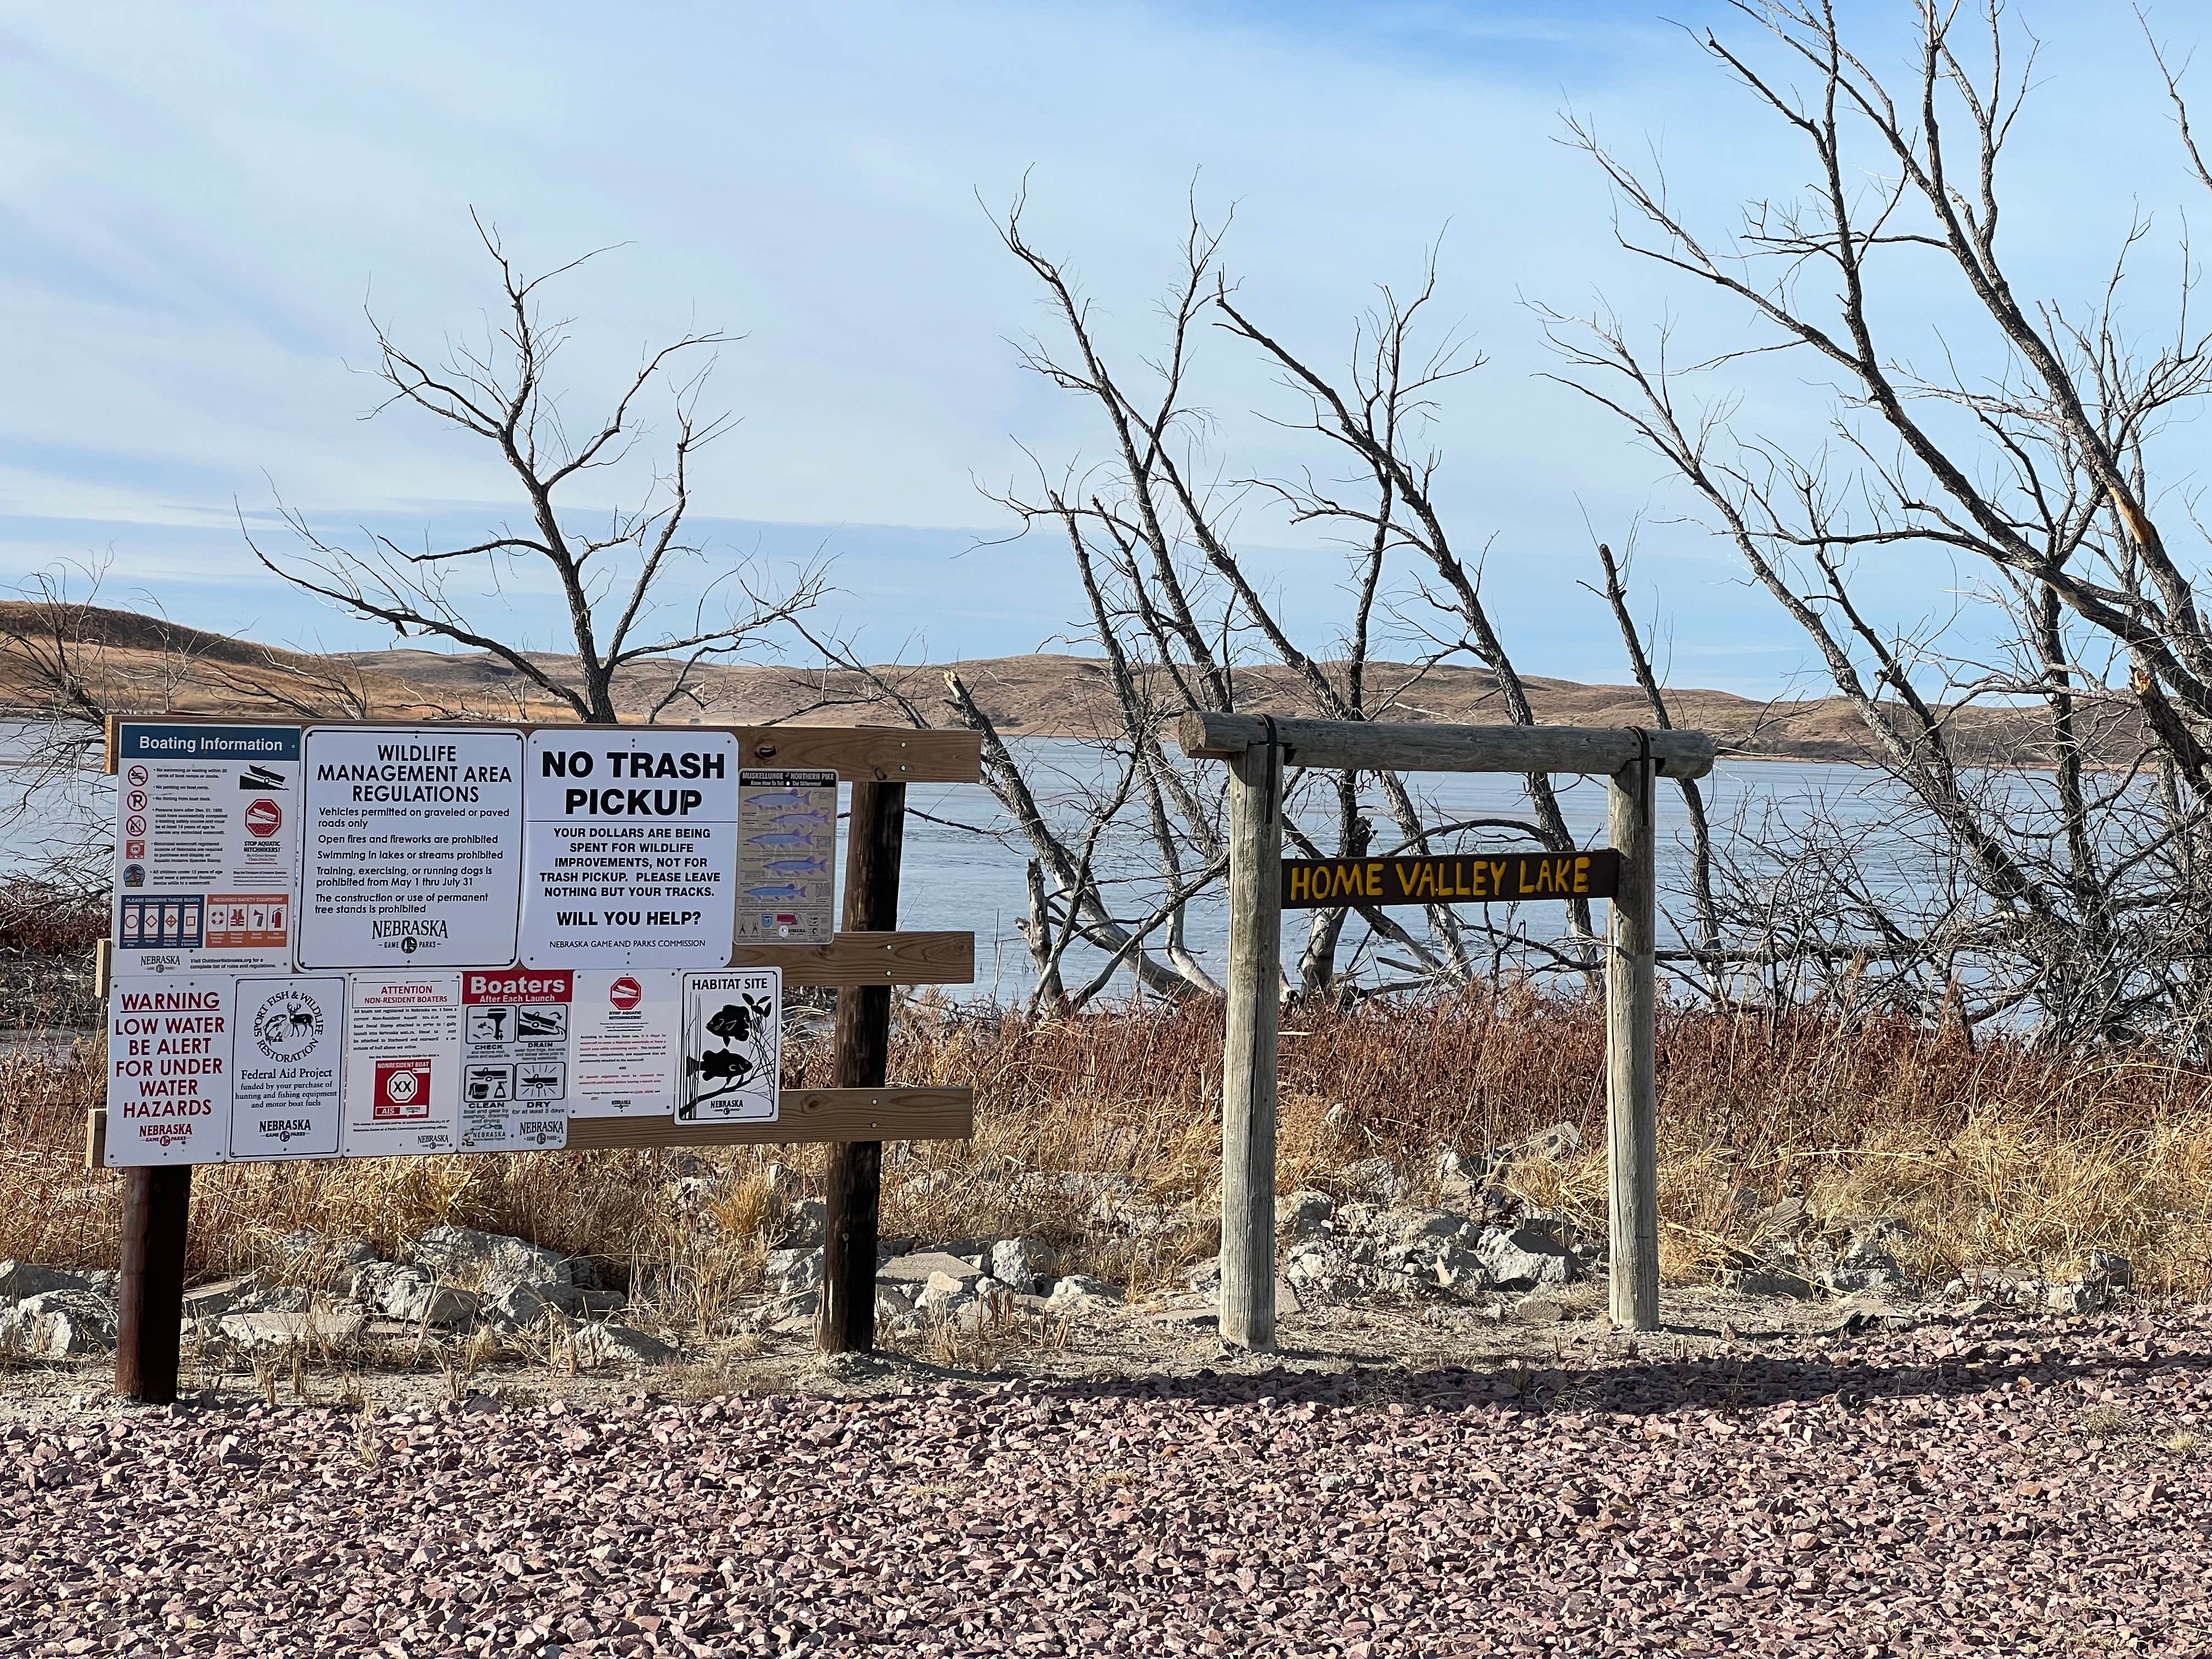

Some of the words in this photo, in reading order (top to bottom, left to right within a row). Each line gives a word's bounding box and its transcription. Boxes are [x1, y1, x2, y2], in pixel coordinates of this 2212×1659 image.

[140, 736, 195, 752] Boating
[201, 737, 282, 751] Information
[377, 745, 455, 761] WILDLIFE
[543, 752, 593, 777] NO
[607, 752, 724, 778] TRASH
[318, 765, 458, 782] MANAGEMENT
[464, 766, 511, 782] AREA
[353, 786, 478, 802] REGULATIONS
[566, 789, 702, 815] PICKUP
[319, 808, 358, 816] Vehicles
[362, 808, 407, 817] permitted
[425, 808, 465, 818] graveled
[480, 809, 509, 818] paved
[348, 819, 368, 829] only
[319, 835, 345, 844] Open
[452, 835, 498, 845] prohibited
[554, 828, 585, 837] YOUR
[590, 828, 644, 837] DOLLARS
[648, 828, 671, 838] ARE
[676, 829, 710, 838] BEING
[570, 843, 607, 852] SPENT
[612, 843, 635, 852] FOR
[640, 843, 693, 852] WILDLIFE
[318, 851, 365, 861] Swimming
[457, 851, 503, 860] prohibited
[555, 858, 652, 869] IMPROVEMENTS,
[657, 858, 681, 867] NOT
[685, 858, 707, 867] FOR
[317, 867, 355, 876] Training,
[359, 867, 408, 876] exercising,
[424, 867, 458, 876] running
[461, 867, 483, 876] dogs
[540, 873, 578, 882] TRASH
[583, 873, 628, 882] PICKUP.
[636, 873, 681, 882] PLEASE
[685, 873, 720, 882] LEAVE
[1290, 864, 1385, 901] HOME
[1396, 861, 1507, 897] VALLEY
[1519, 857, 1590, 893] LAKE
[317, 878, 364, 888] prohibited
[368, 878, 388, 886] from
[391, 878, 411, 888] May
[443, 878, 460, 887] July
[438, 893, 488, 903] permanent
[545, 887, 596, 896] NOTHING
[601, 888, 625, 896] BUT
[629, 887, 661, 896] YOUR
[665, 887, 714, 896] TRACKS.
[315, 905, 333, 913] tree
[370, 905, 375, 913] is
[379, 905, 426, 915] prohibited
[557, 912, 597, 926] WILL
[604, 912, 640, 925] YOU
[647, 911, 701, 925] HELP?
[372, 921, 448, 940] NEBRASKA
[141, 956, 180, 967] NEBRASKA
[471, 977, 565, 994] Boaters
[693, 979, 741, 990] HABITAT
[744, 978, 767, 989] SITE
[122, 992, 219, 1009] WARNING
[253, 1003, 269, 1037] SPORT
[268, 991, 289, 1007] FISH
[291, 991, 299, 999] &
[300, 993, 324, 1036] WILDLIFE
[116, 1019, 158, 1035] LOW
[166, 1017, 224, 1034] WATER
[129, 1040, 150, 1055] BE
[157, 1038, 211, 1055] ALERT
[256, 1037, 319, 1063] RESTORATION
[116, 1060, 153, 1077] FOR
[161, 1058, 222, 1075] UNDER
[241, 1069, 275, 1079] Federal
[279, 1068, 296, 1078] Aid
[300, 1068, 332, 1080] Project
[139, 1080, 198, 1097] WATER
[294, 1082, 323, 1090] purchase
[393, 1081, 412, 1093] XX
[124, 1099, 211, 1118] HAZARDS
[710, 1100, 743, 1108] NEBRASKA
[139, 1124, 192, 1139] NEBRASKA
[259, 1119, 311, 1134] NEBRASKA
[520, 1121, 563, 1137] NEBRASKA
[418, 1135, 448, 1145] NEBRASKA
